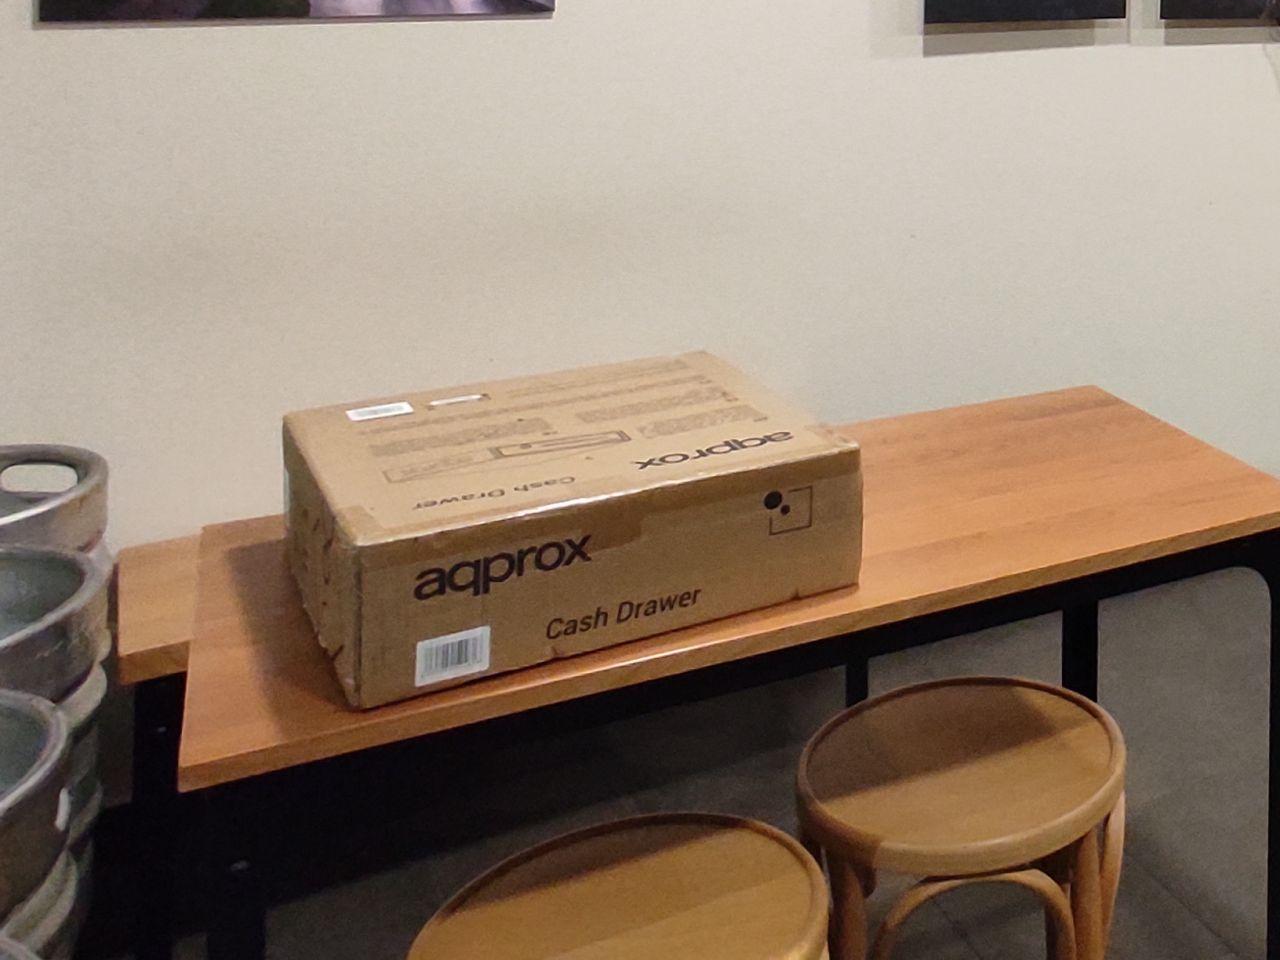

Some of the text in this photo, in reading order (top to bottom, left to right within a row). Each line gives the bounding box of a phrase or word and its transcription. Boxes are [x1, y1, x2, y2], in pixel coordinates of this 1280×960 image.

[635, 431, 793, 470] aqprox
[413, 476, 575, 510] Cash Drawer
[414, 534, 592, 600] aqprox
[546, 587, 702, 640] Cash Drawer
